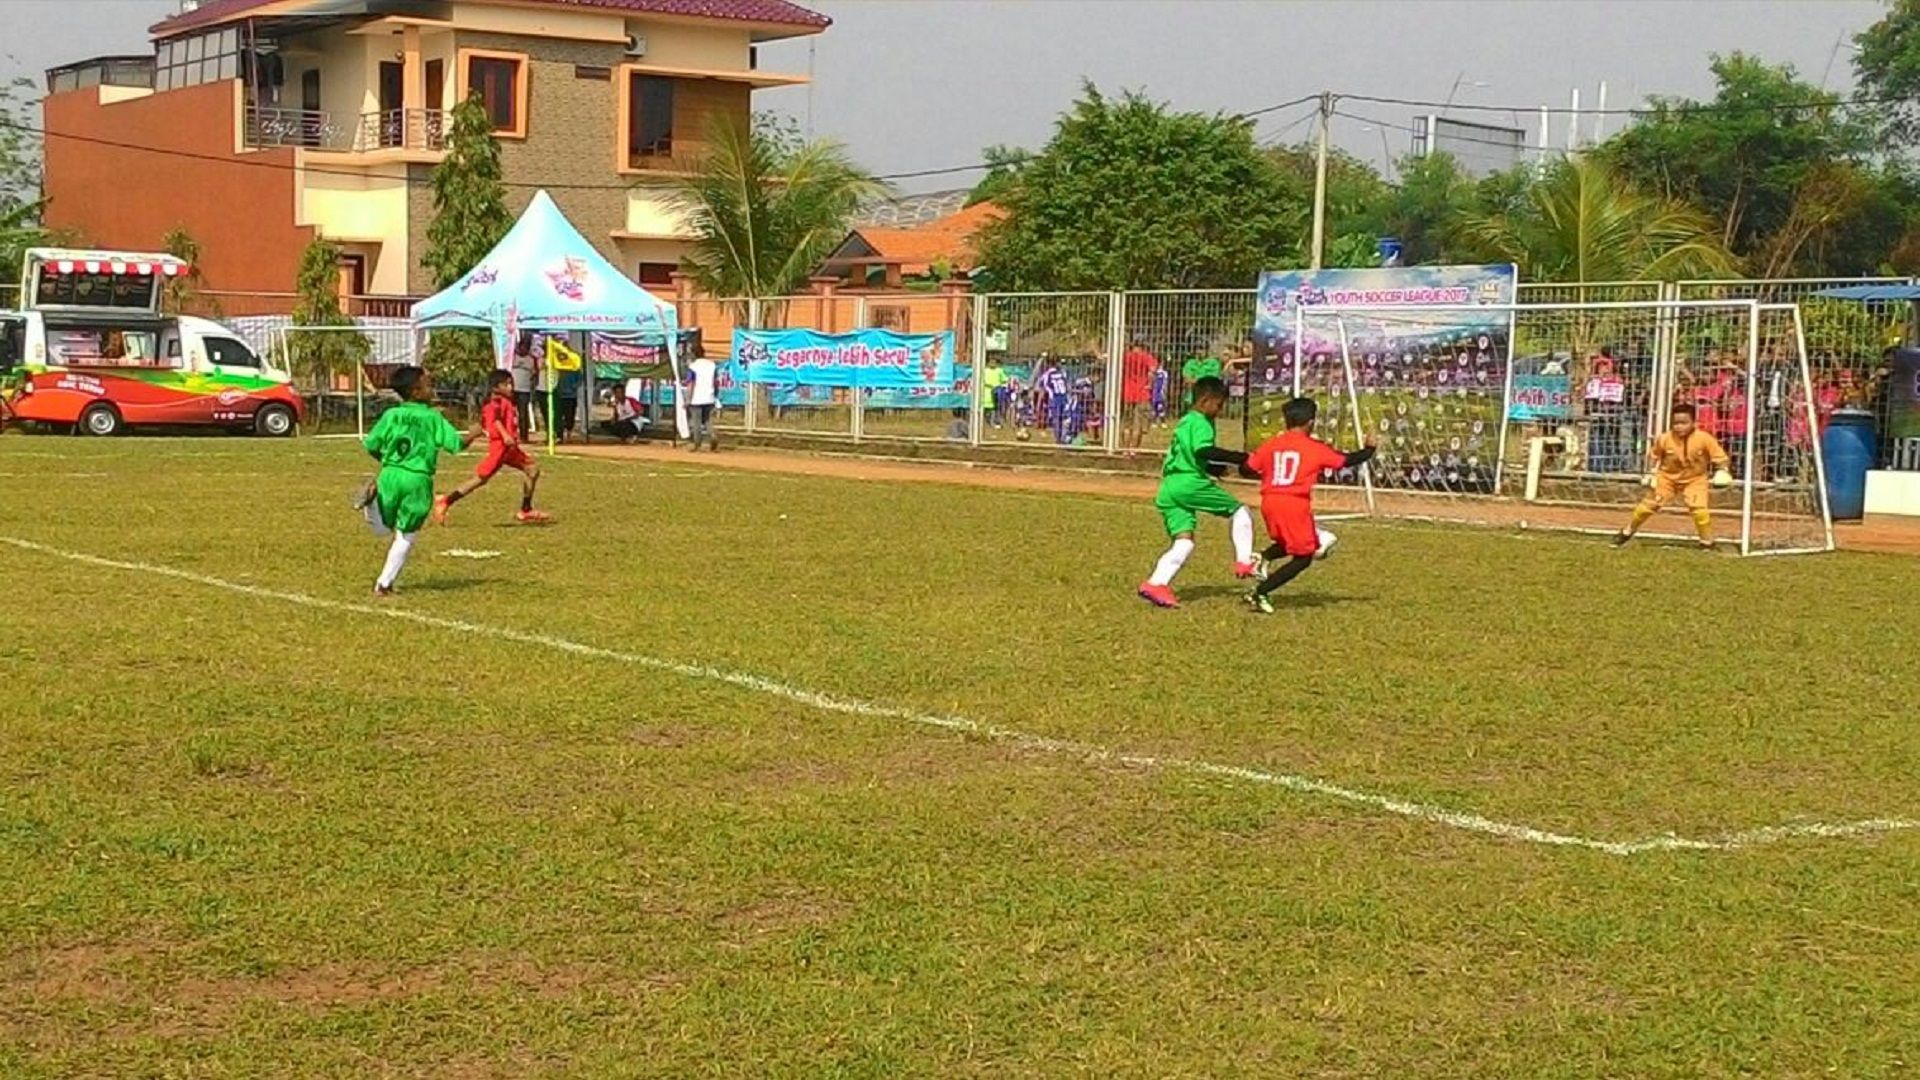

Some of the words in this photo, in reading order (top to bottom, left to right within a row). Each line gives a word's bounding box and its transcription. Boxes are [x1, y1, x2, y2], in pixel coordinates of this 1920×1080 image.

[1330, 291, 1363, 304] YOUTH
[1364, 290, 1402, 304] SOCCER
[1403, 288, 1441, 303] LEAGUE
[1272, 450, 1300, 485] 10
